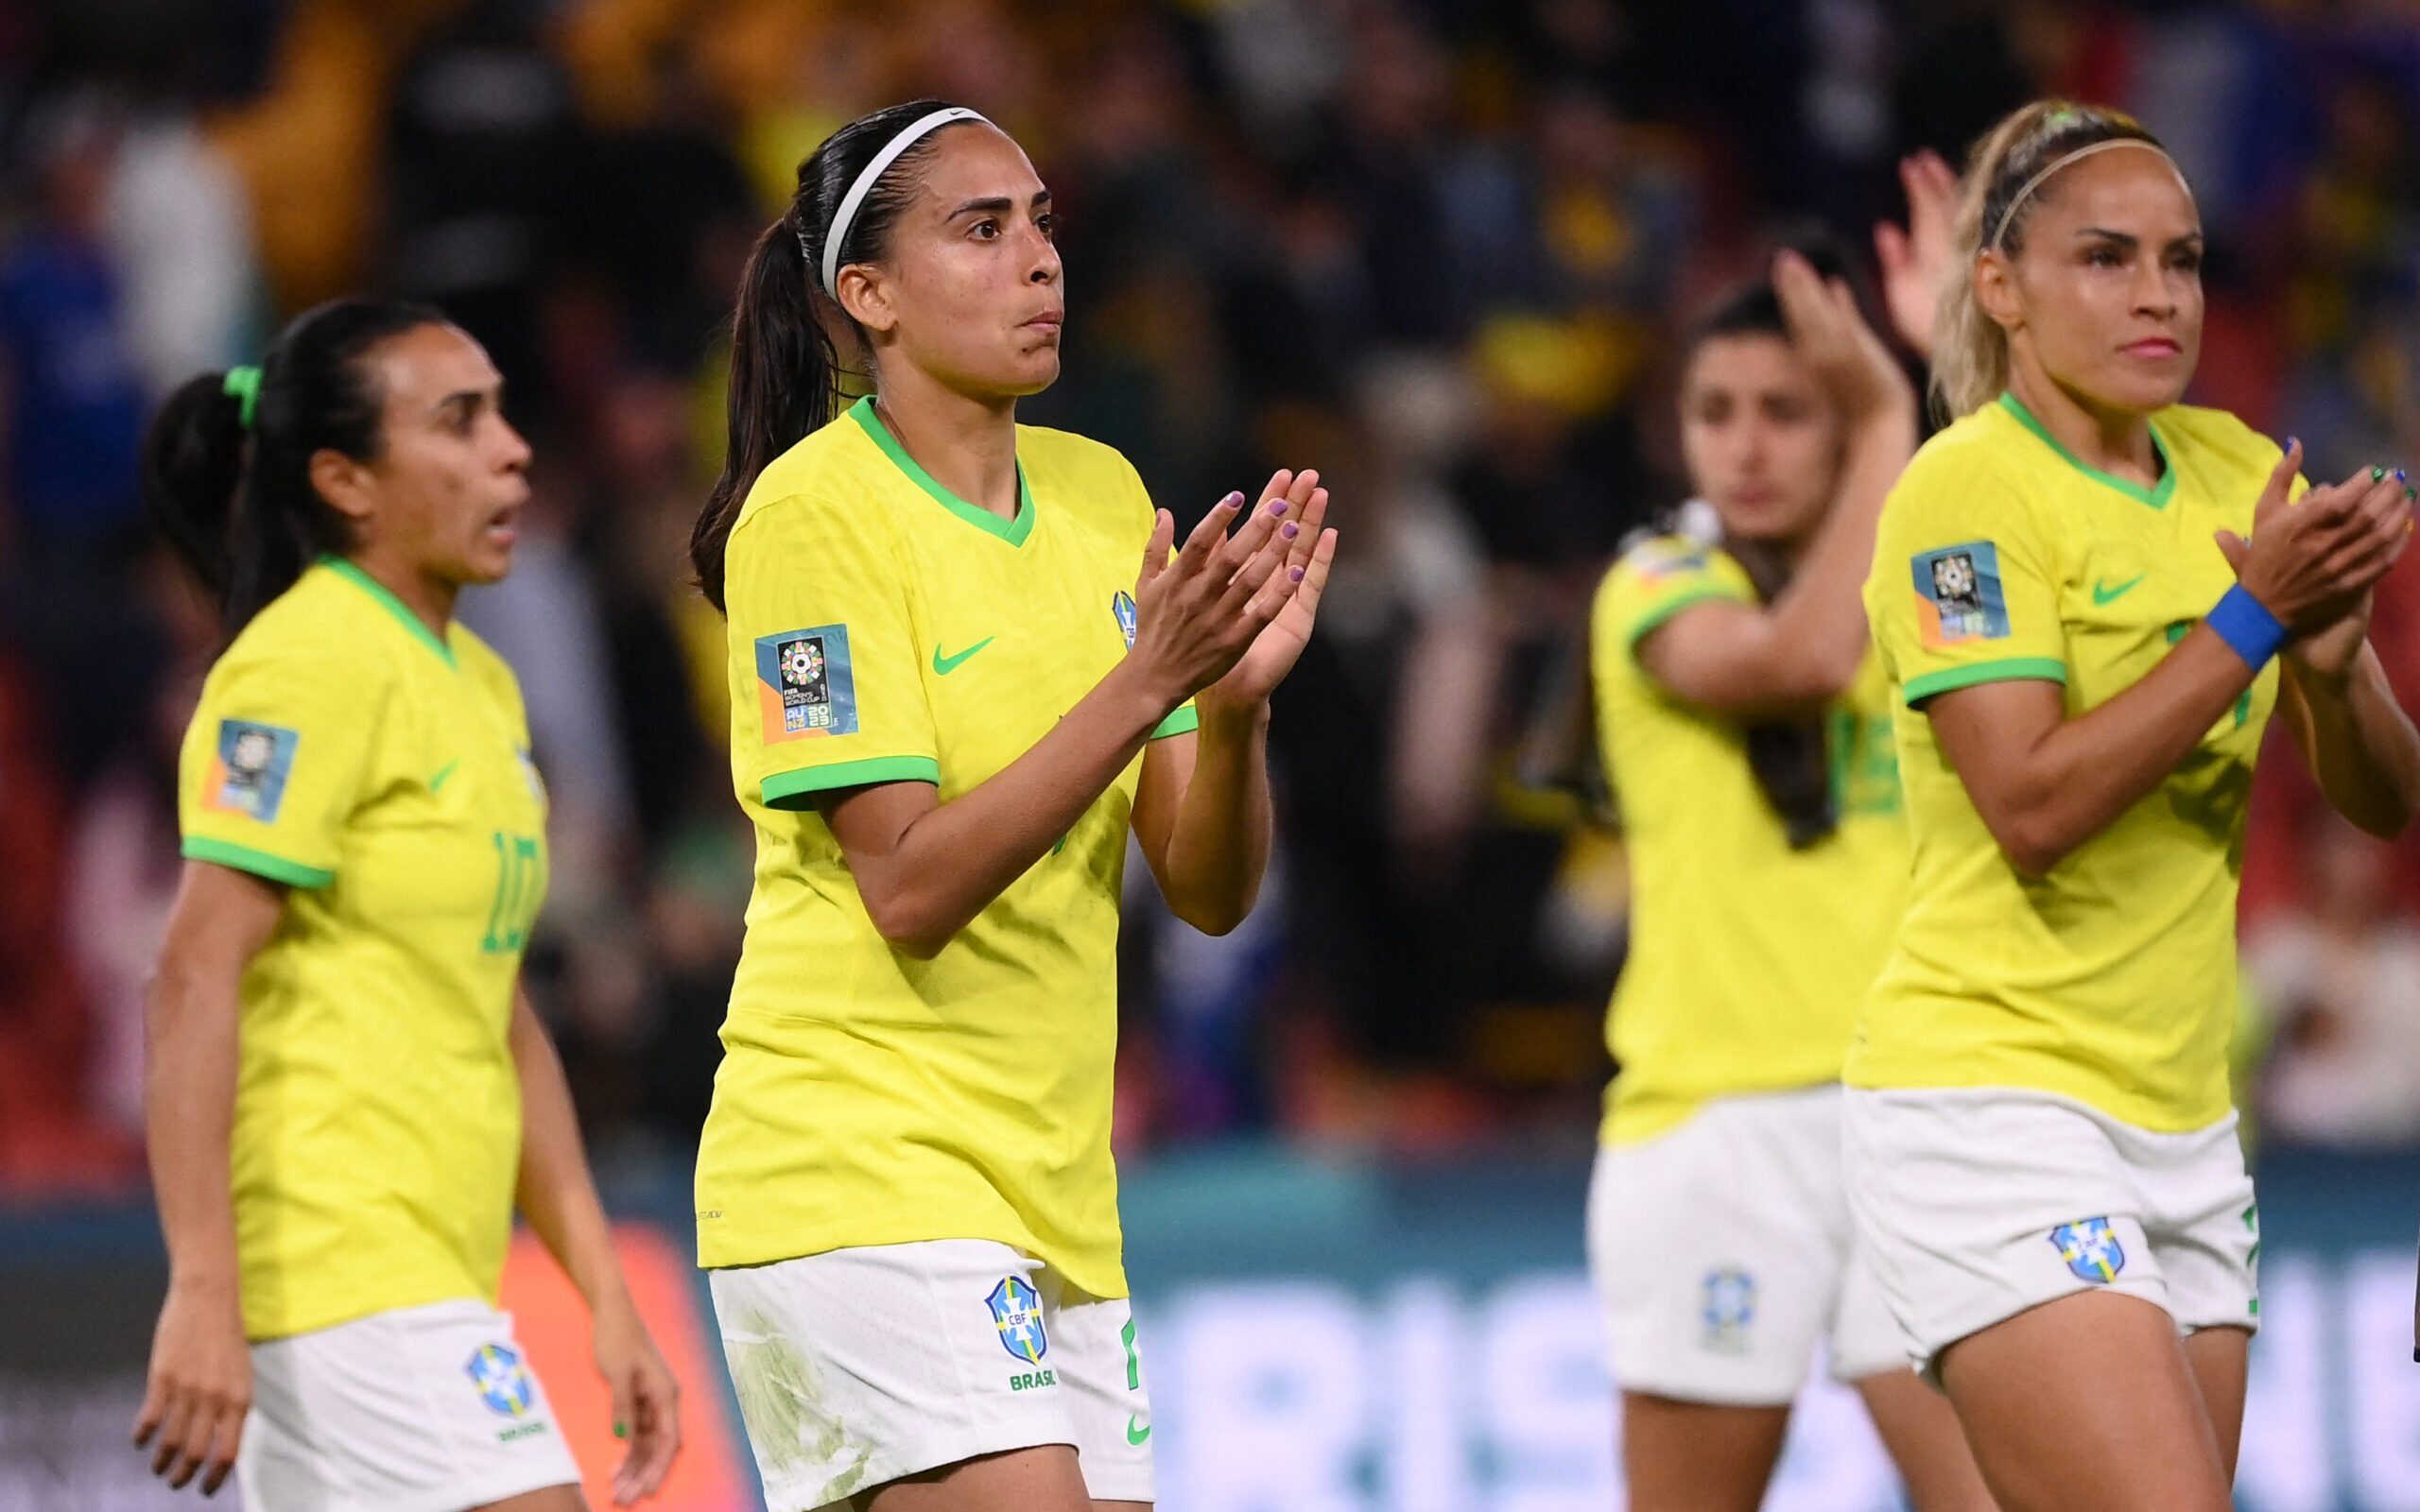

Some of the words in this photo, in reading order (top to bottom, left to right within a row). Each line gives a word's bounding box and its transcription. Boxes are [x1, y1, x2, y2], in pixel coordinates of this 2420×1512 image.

[786, 707, 804, 720] AU
[808, 705, 828, 716] 20
[787, 718, 804, 730] NZ
[809, 715, 829, 726] 23
[1009, 1313, 1028, 1326] CBF
[1010, 1370, 1056, 1391] BRASIL
